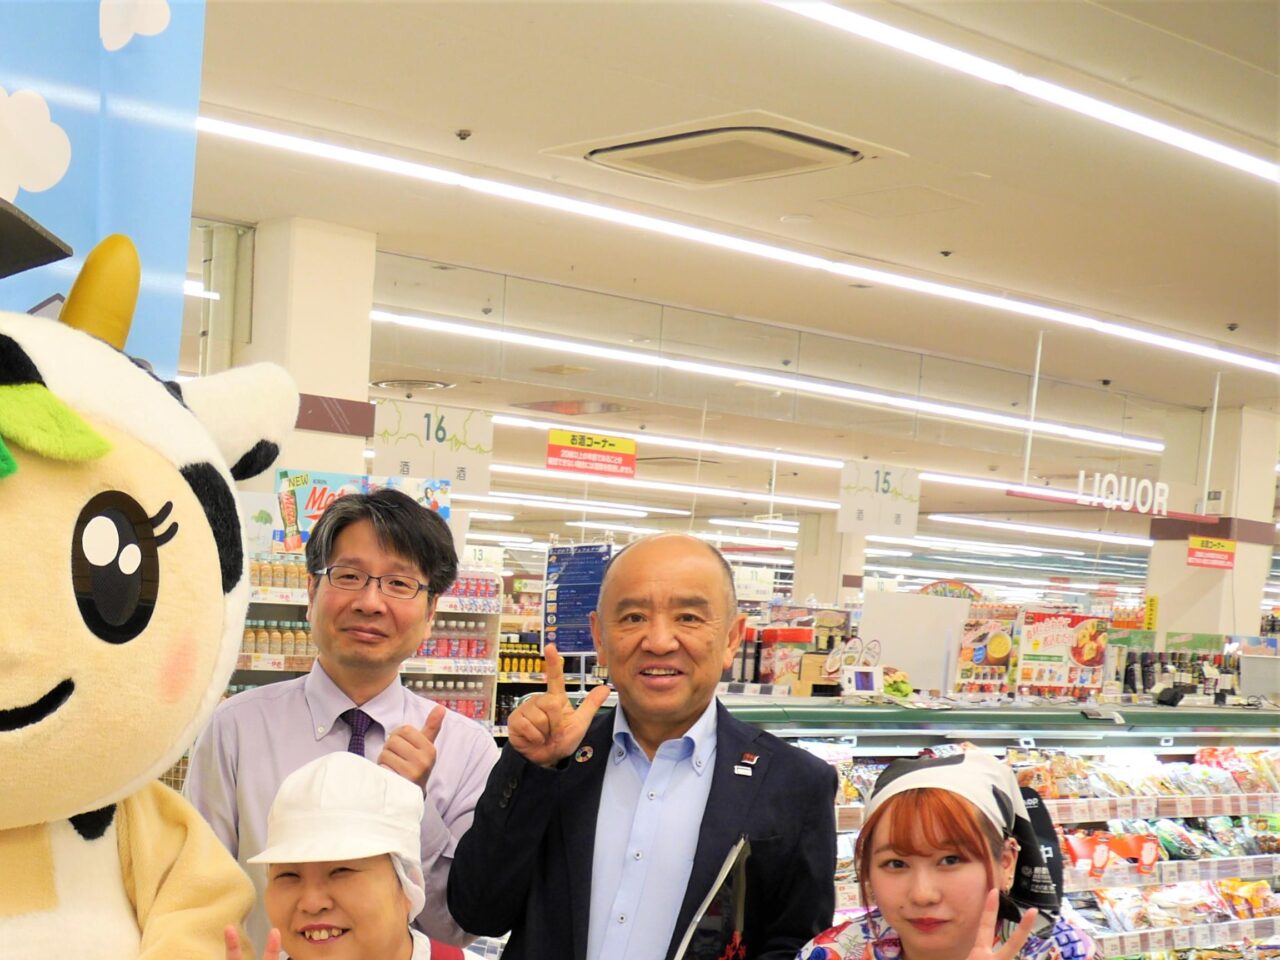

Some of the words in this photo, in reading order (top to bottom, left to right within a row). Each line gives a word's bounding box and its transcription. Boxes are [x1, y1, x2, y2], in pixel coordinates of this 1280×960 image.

[423, 413, 447, 443] 16
[570, 434, 616, 448] お酒コーナー
[288, 474, 309, 488] NEW
[874, 470, 891, 494] 15
[1076, 470, 1169, 516] LIQUOR
